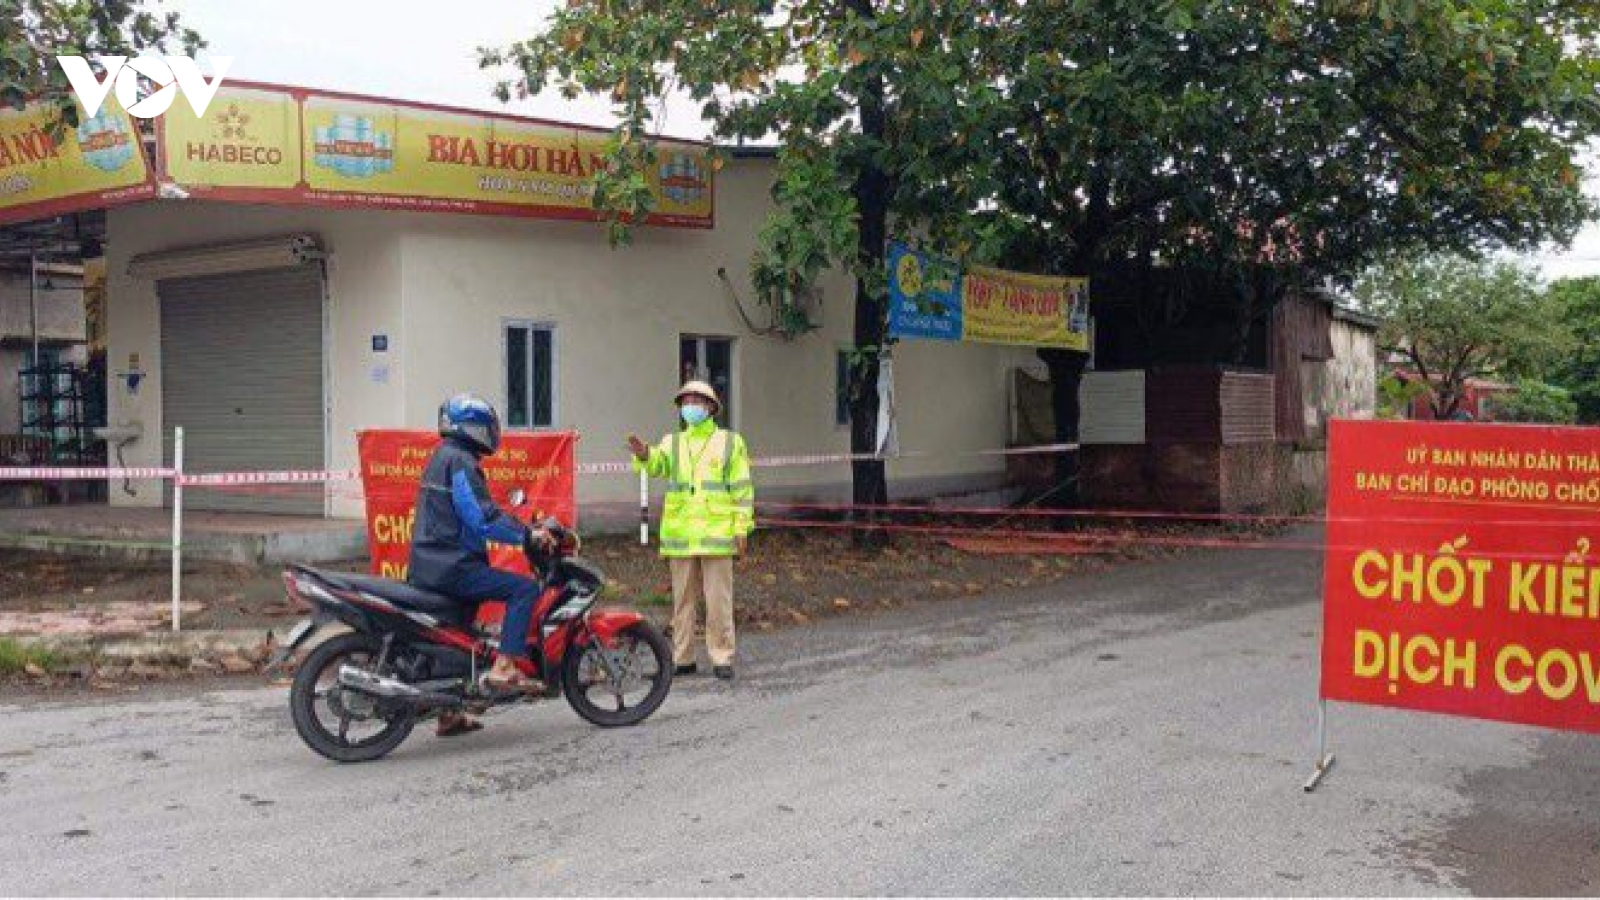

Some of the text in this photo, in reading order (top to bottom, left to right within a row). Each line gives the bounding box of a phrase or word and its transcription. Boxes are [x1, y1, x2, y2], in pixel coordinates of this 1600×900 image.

[186, 142, 282, 165] HABECO
[427, 134, 482, 167] BIA
[546, 143, 586, 176] HÀ
[1432, 448, 1466, 466] BAN
[1471, 448, 1520, 468] NHÂN
[1525, 449, 1561, 471] DÂN
[1356, 472, 1391, 491] BAN
[1434, 476, 1474, 499] ĐẠO
[1482, 475, 1549, 500] PHÒNG
[1353, 533, 1493, 608] CHỐT
[1353, 629, 1477, 695] DỊCH
